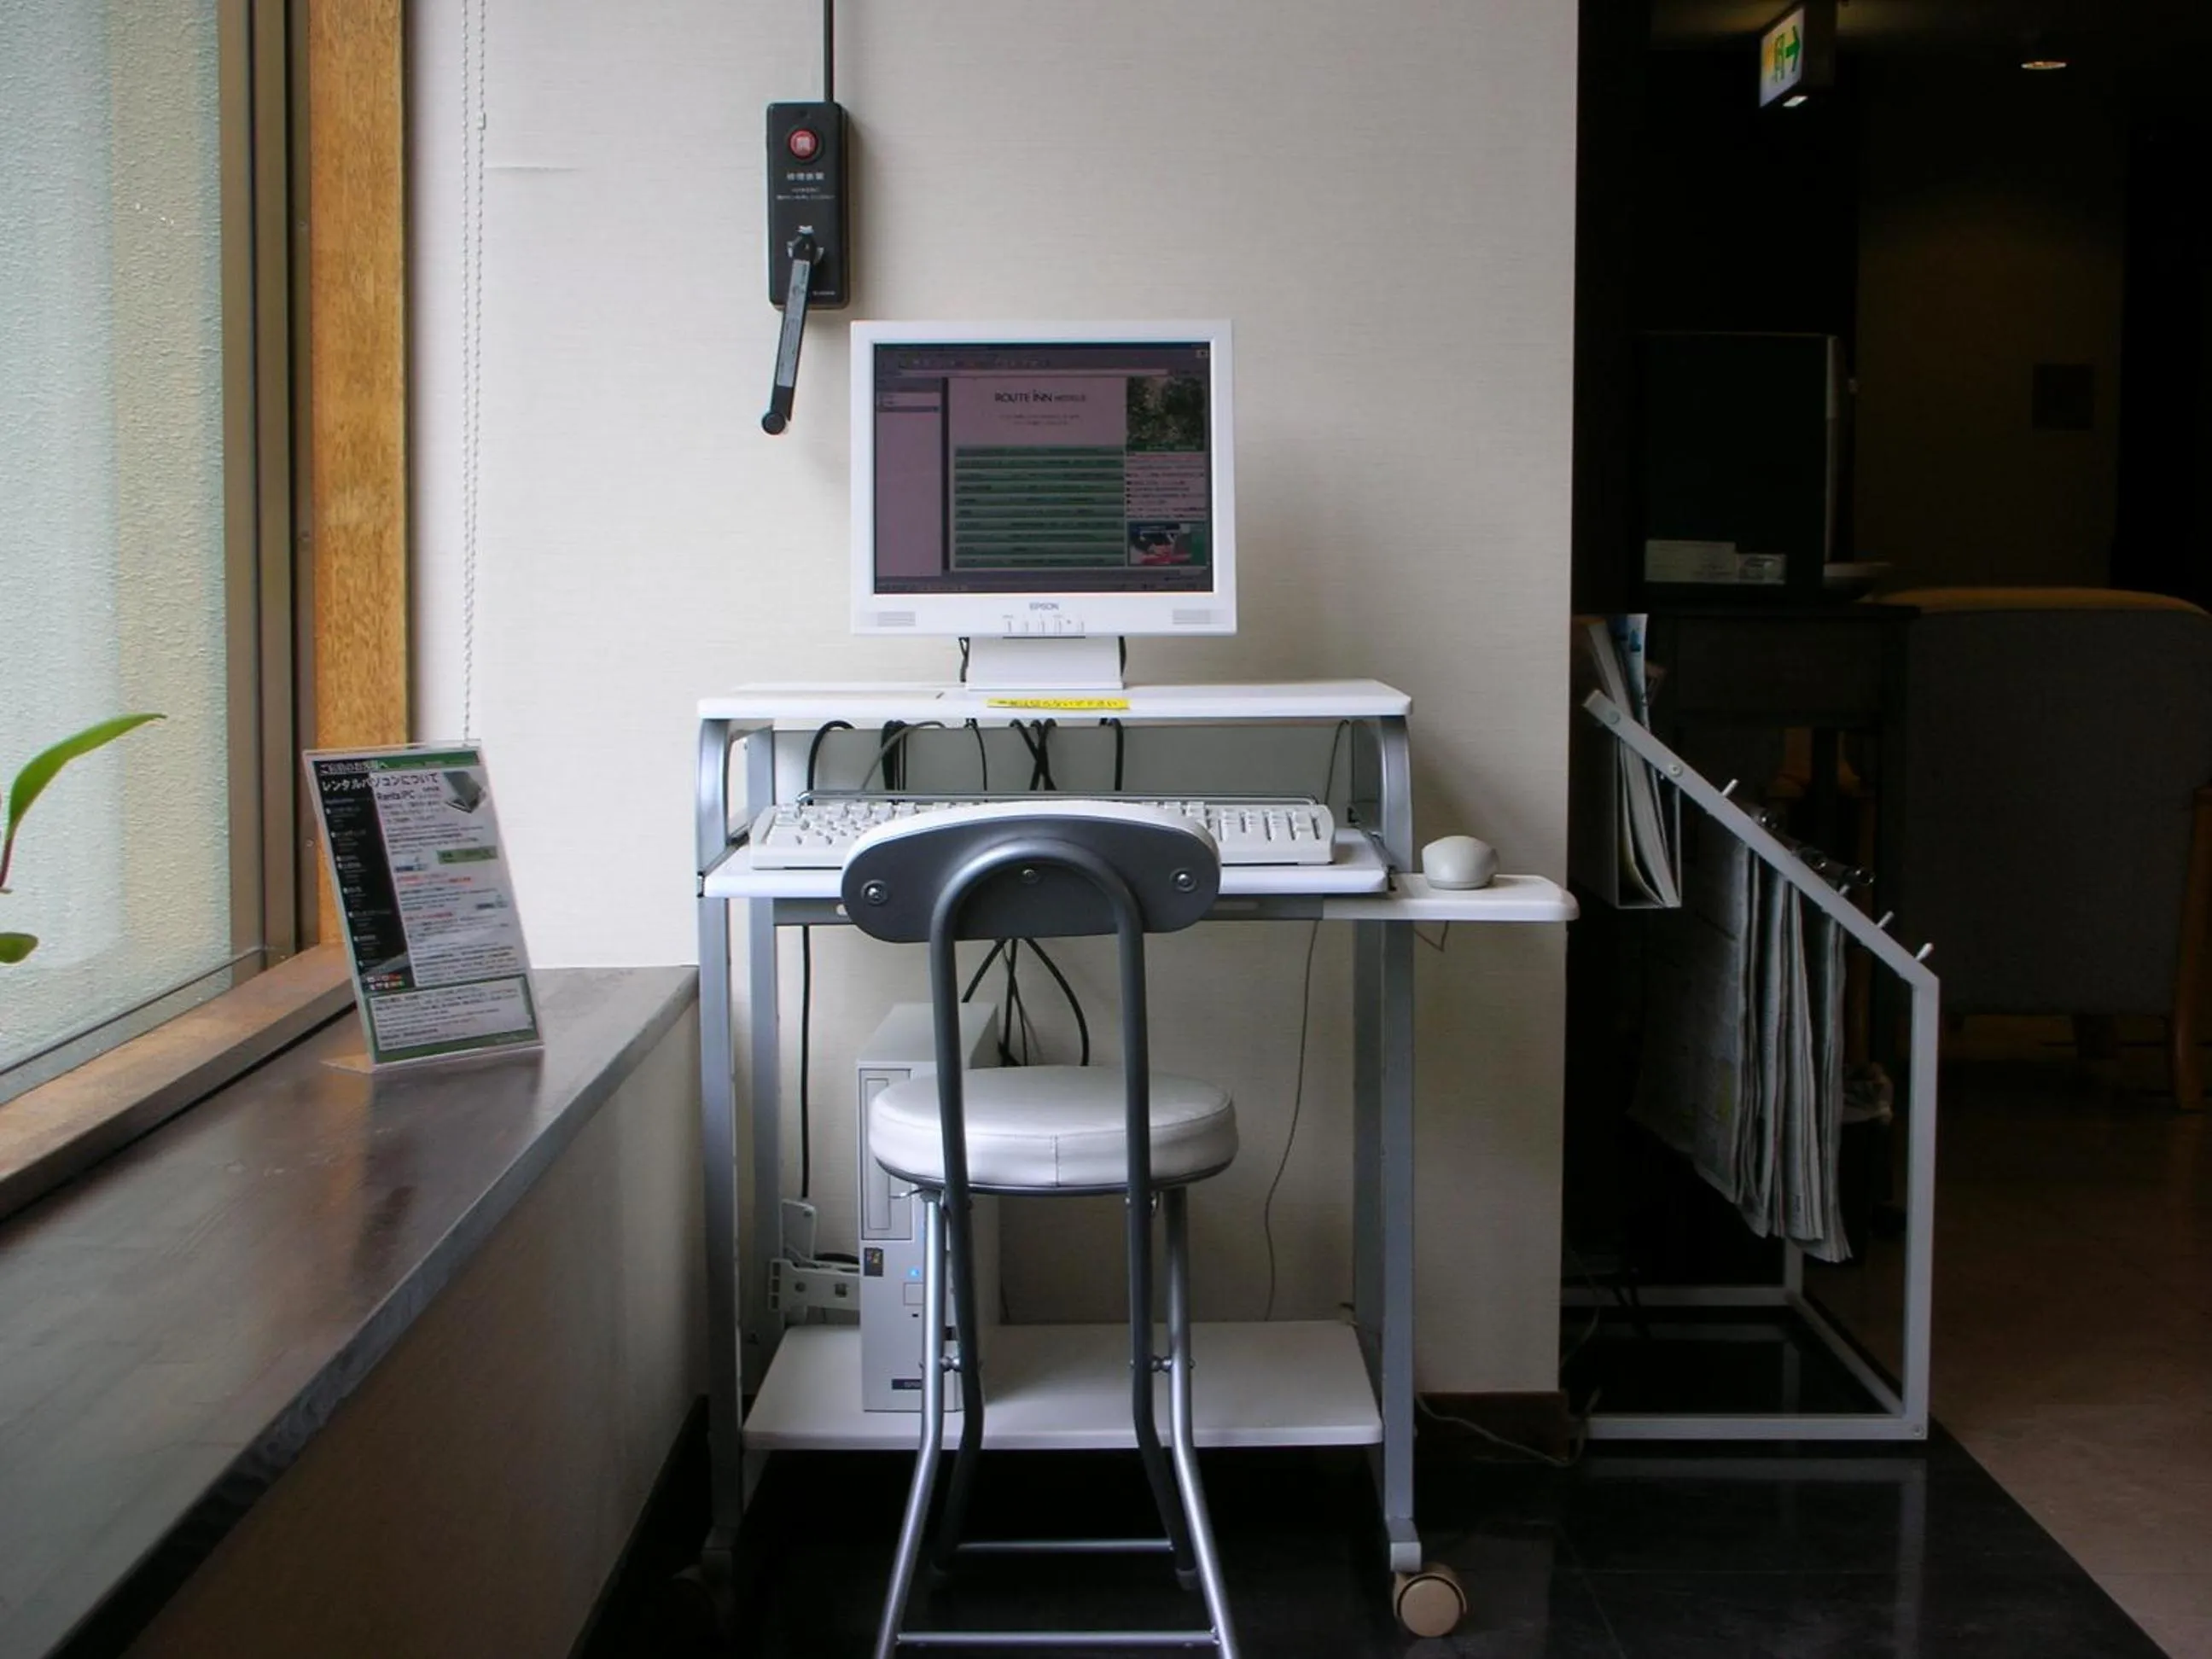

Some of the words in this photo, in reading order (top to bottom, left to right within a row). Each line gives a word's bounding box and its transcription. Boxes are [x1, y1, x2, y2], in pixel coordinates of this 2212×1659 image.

[994, 392, 1030, 403] ROUTE
[1028, 602, 1060, 611] EPSON
[323, 772, 438, 792] レンタルパソコンについて
